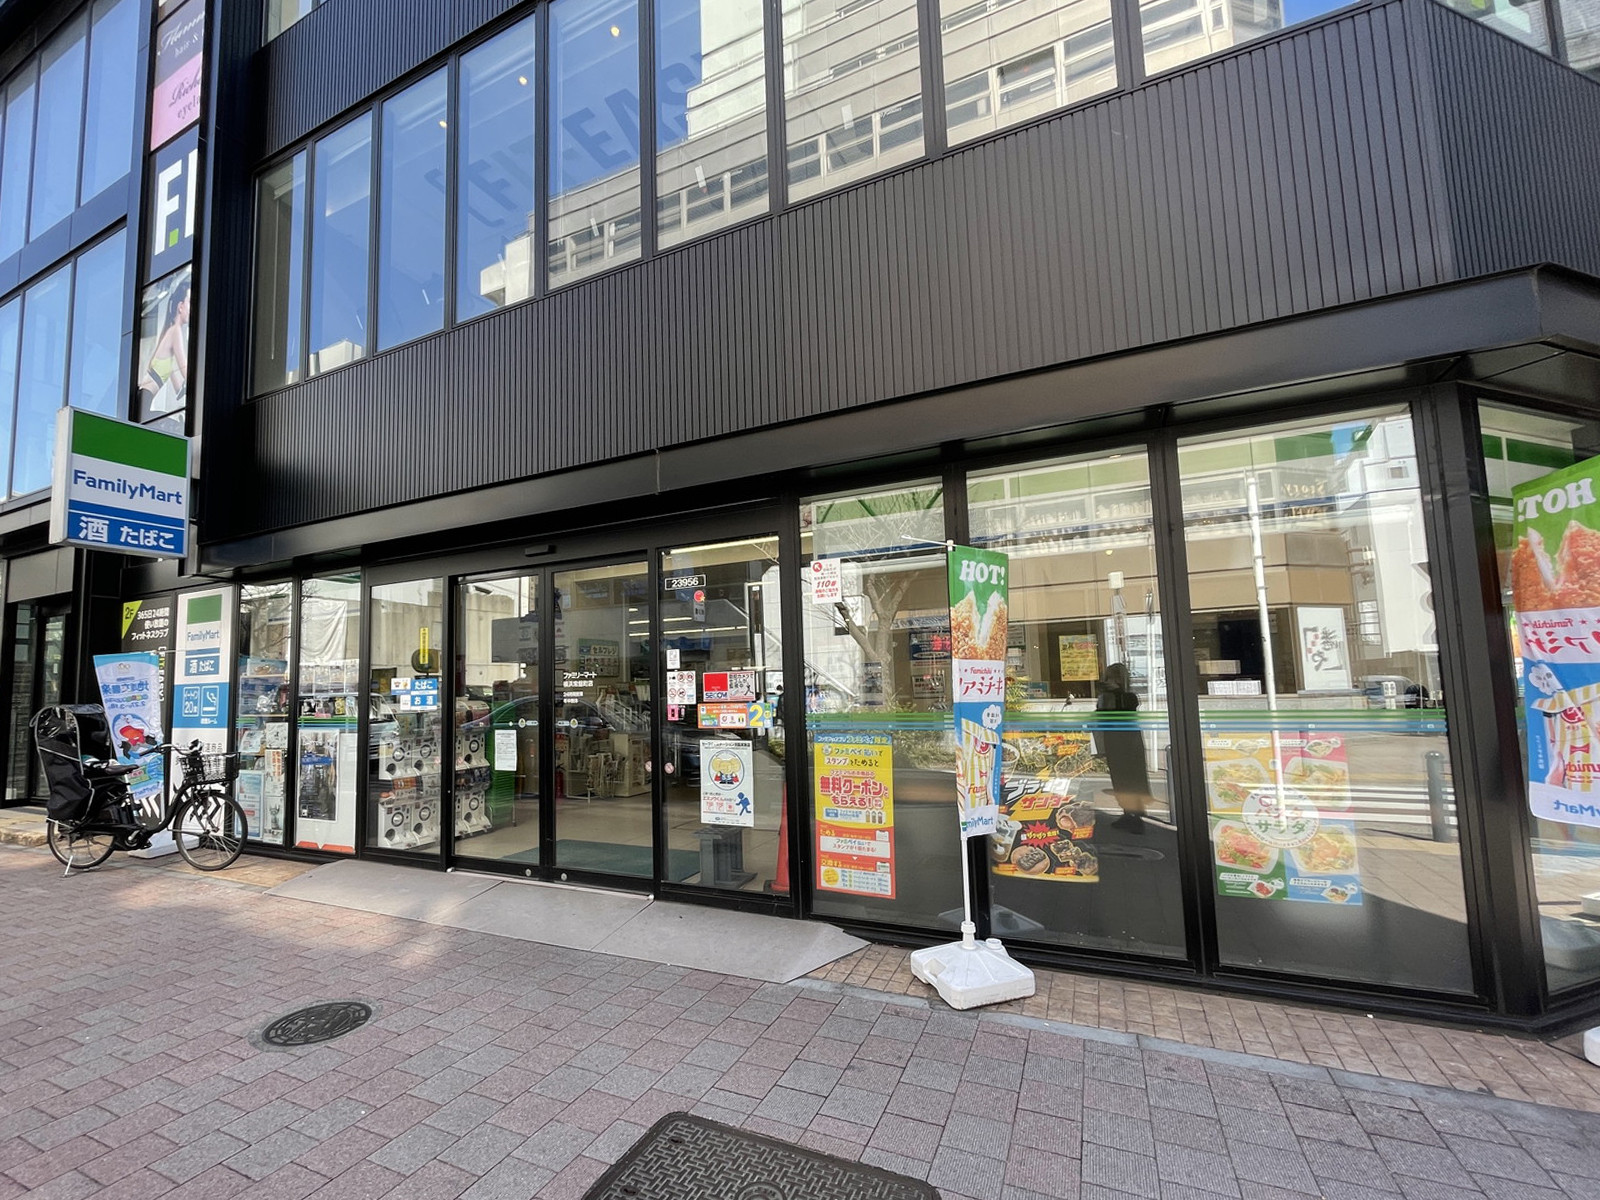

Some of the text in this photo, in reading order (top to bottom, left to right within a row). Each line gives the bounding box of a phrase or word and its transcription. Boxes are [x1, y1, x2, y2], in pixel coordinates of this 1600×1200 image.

[73, 469, 183, 505] FamilyMart
[79, 515, 175, 549] 酒 たばこ
[958, 560, 1006, 586] HOT!
[671, 577, 699, 588] 23956
[124, 606, 135, 620] 2F
[131, 628, 169, 641] フィットネスクラブ
[187, 629, 220, 642] FamilyMart
[189, 658, 215, 674] 酒 たばこ
[562, 671, 598, 680] ファミリーマート
[820, 776, 883, 796] 無料クーポン
